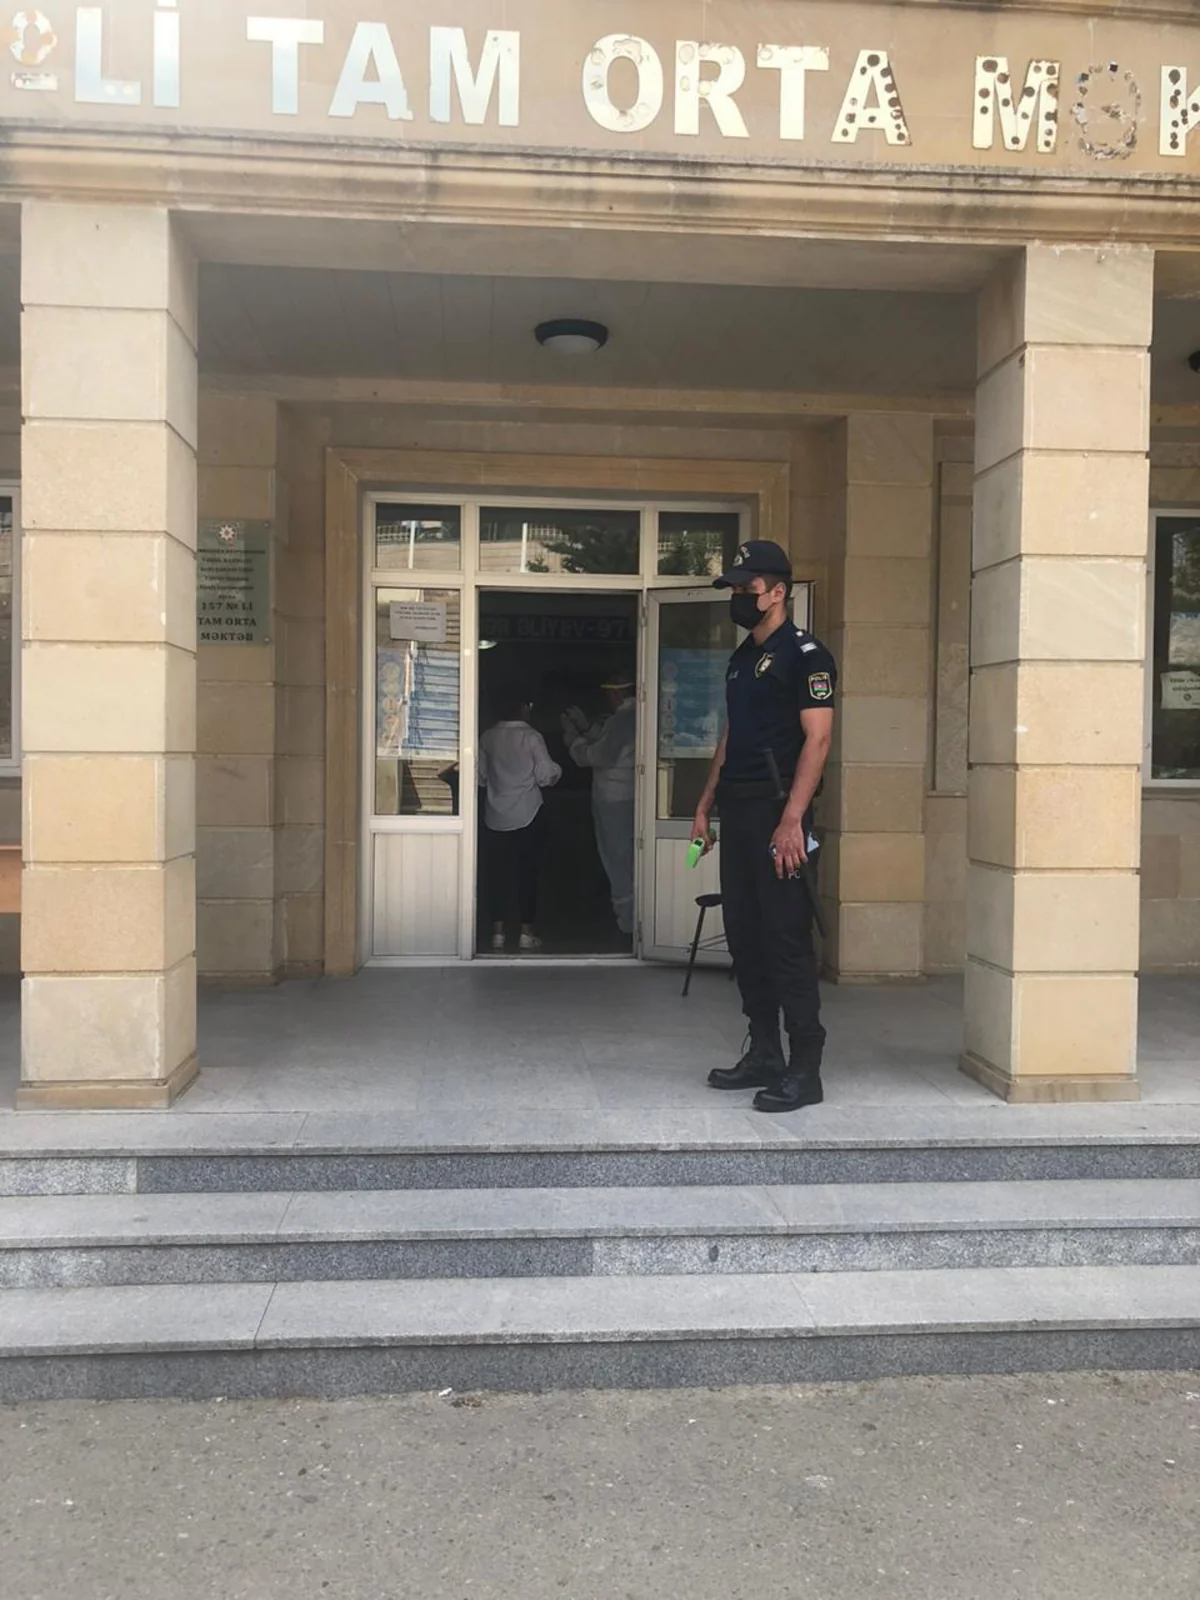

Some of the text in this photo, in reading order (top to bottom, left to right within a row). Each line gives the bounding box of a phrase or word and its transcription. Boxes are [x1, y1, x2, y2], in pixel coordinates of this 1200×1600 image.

[246, 16, 520, 126] TAM
[582, 33, 912, 146] ORTA
[198, 617, 258, 627] TAM ORTA
